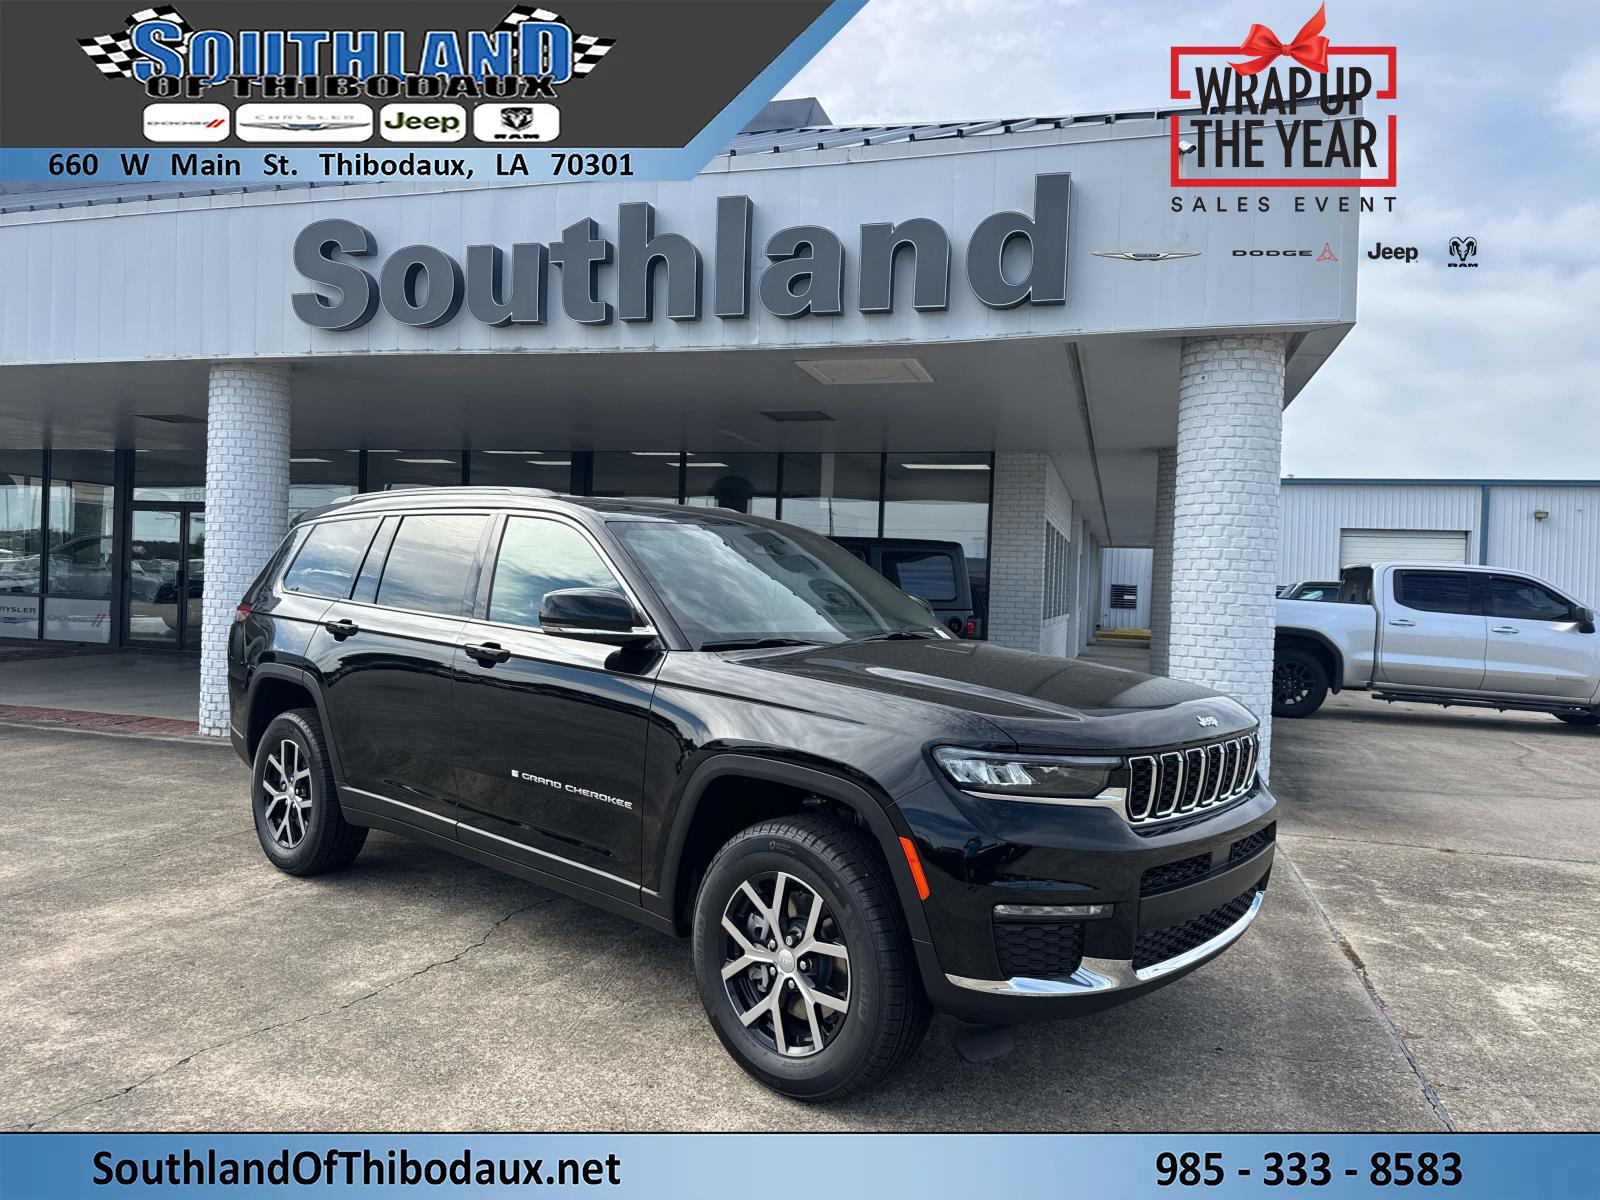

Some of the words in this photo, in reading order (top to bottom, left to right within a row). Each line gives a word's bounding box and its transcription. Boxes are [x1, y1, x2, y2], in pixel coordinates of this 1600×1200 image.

[291, 171, 1073, 331] Southland
[521, 772, 562, 788] GRAND
[565, 784, 633, 810] CHEROKEE
